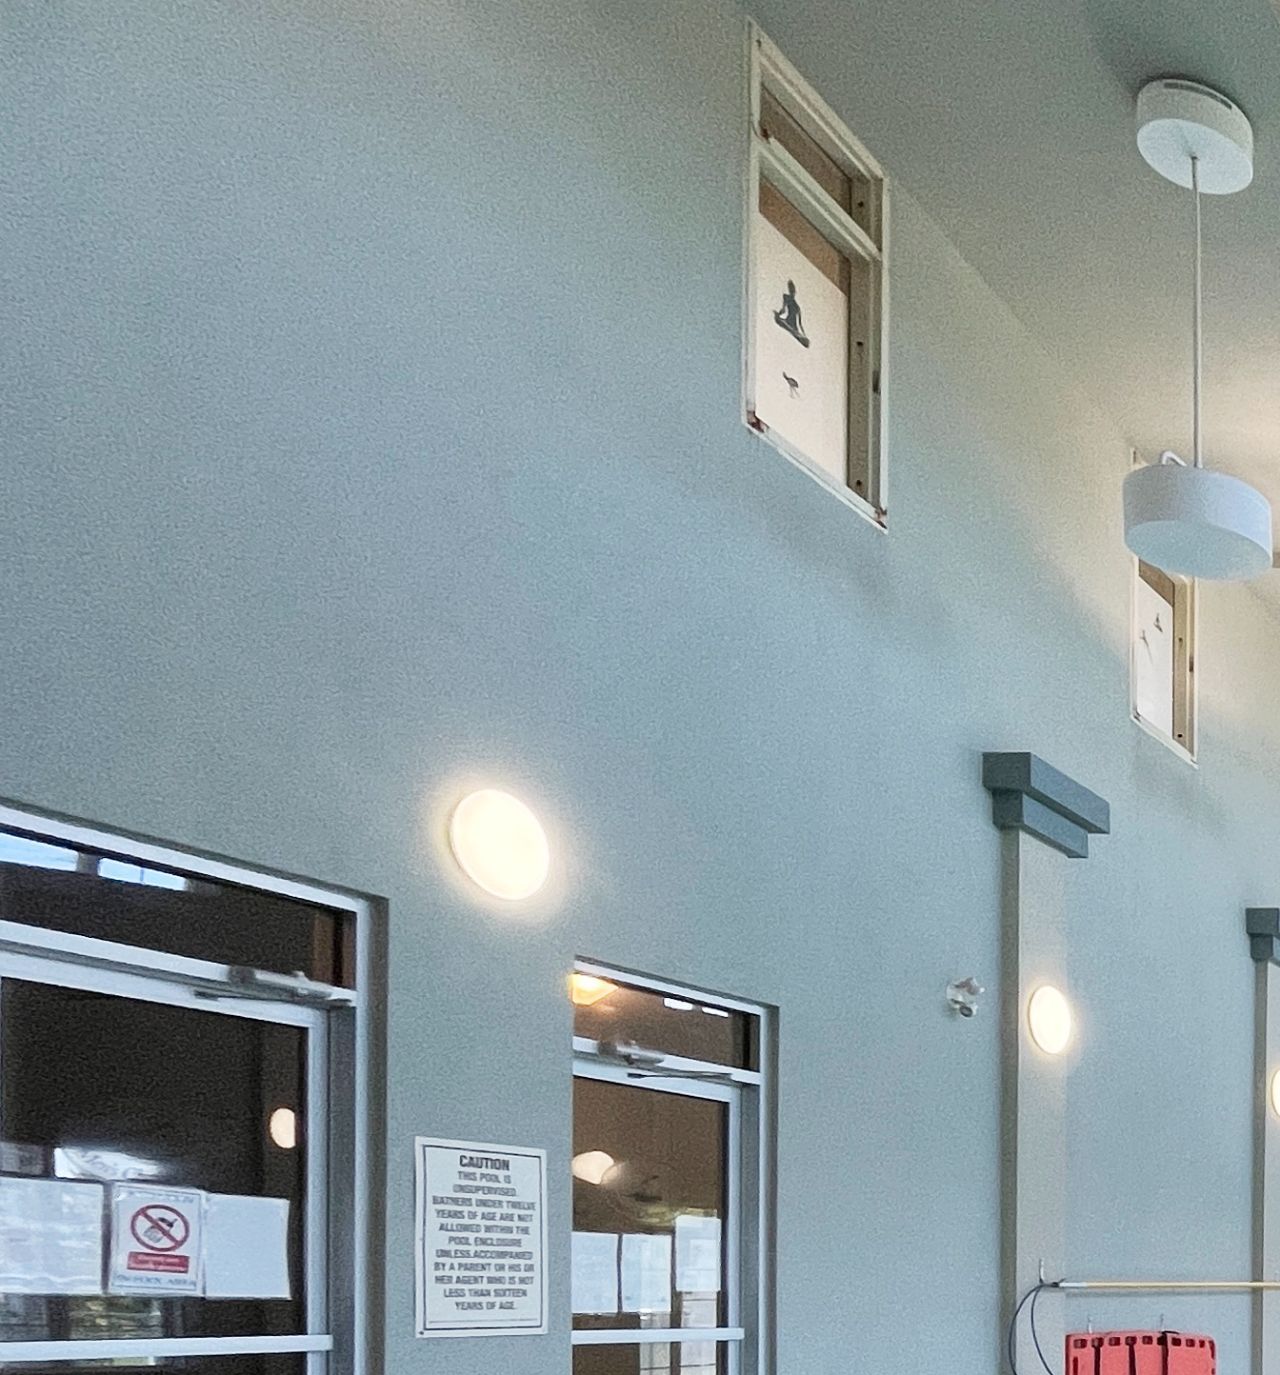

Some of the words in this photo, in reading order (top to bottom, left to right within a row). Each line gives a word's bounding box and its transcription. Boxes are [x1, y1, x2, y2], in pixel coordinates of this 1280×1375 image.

[459, 1155, 510, 1171] CAUTION
[458, 1171, 477, 1181] THIS
[480, 1173, 501, 1183] POOL
[435, 1209, 465, 1219] YEARS
[467, 1211, 478, 1220] OF
[480, 1212, 496, 1221] AGE
[499, 1213, 515, 1222] ARE
[448, 1236, 472, 1246] POOL
[433, 1262, 446, 1271] BY
[448, 1262, 455, 1271] A
[458, 1262, 492, 1272] PARENT
[455, 1275, 484, 1285] AGENT
[443, 1288, 466, 1298] LESS
[468, 1288, 491, 1298] THAN
[455, 1301, 484, 1311] YEARS
[486, 1301, 497, 1310] OF
